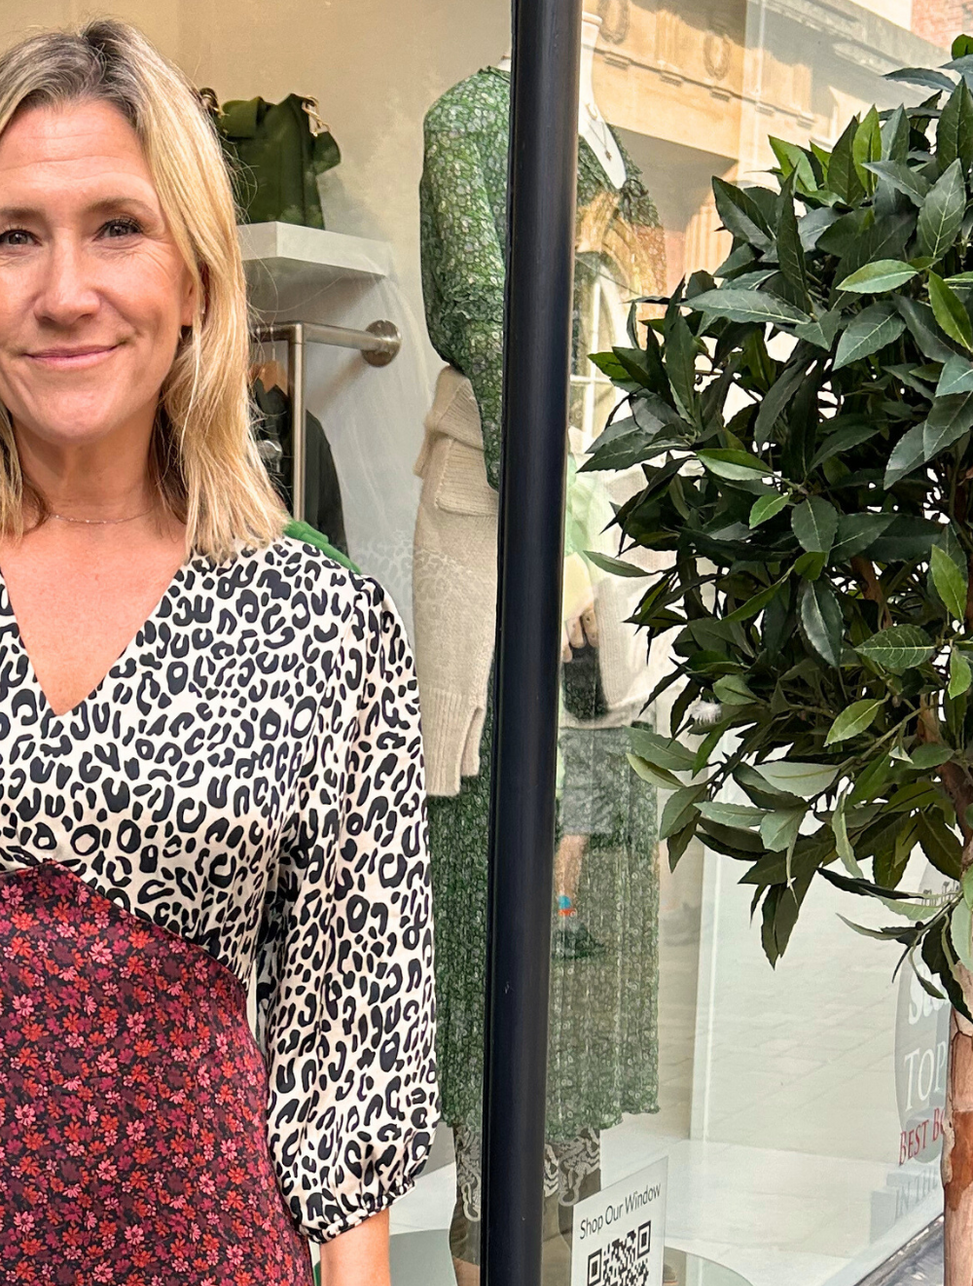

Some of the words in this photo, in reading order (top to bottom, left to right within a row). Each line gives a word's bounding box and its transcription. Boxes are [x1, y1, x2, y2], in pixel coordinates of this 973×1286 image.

[903, 1040, 946, 1113] TOP
[898, 1119, 929, 1167] BEST
[580, 1217, 604, 1240] Shop
[605, 1204, 624, 1225] Our
[624, 1183, 661, 1215] Window
